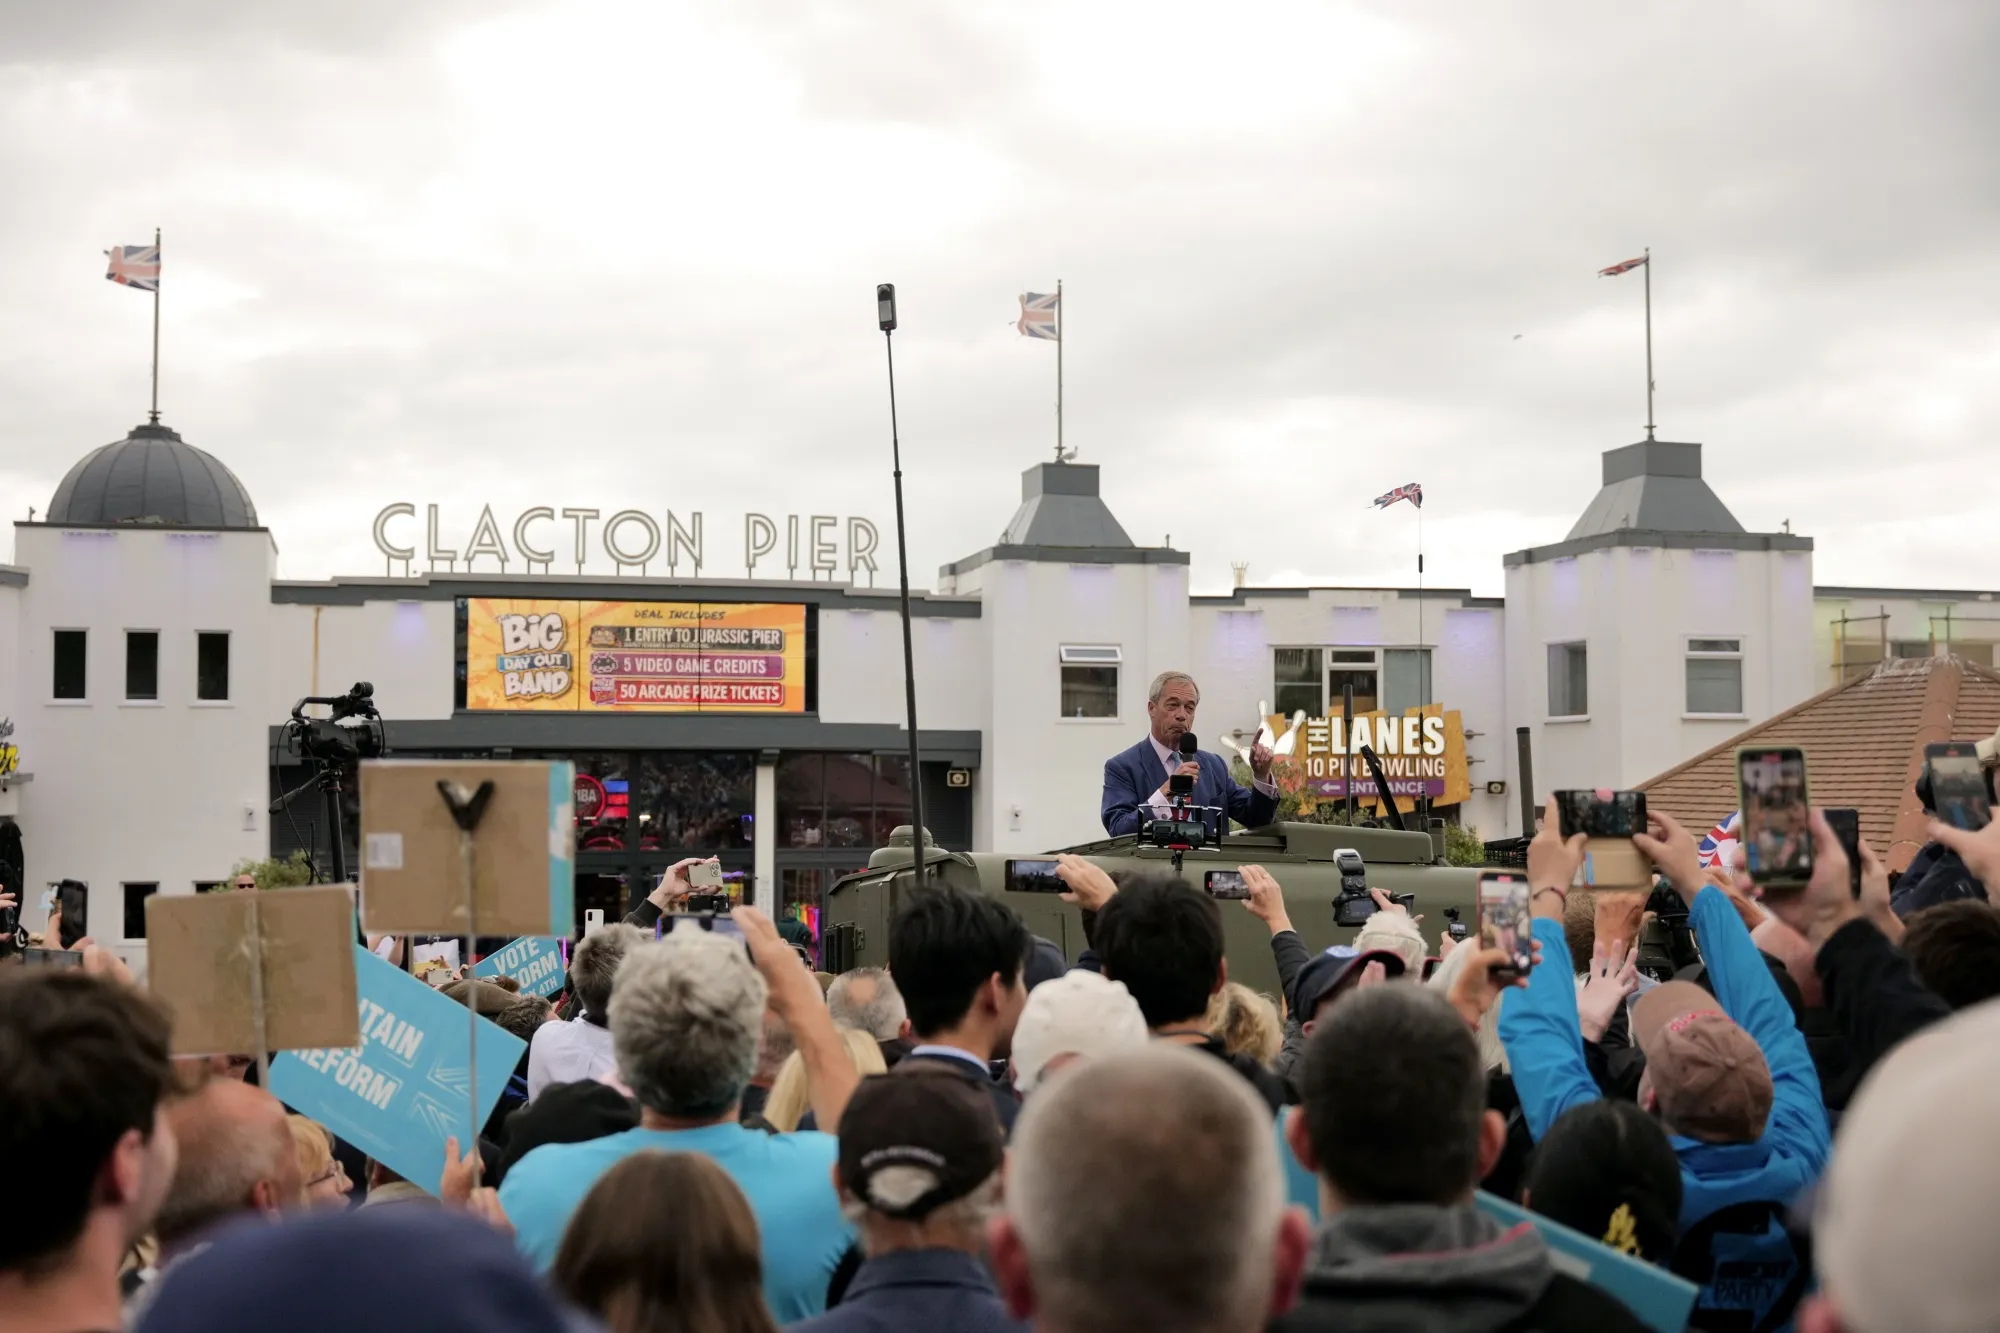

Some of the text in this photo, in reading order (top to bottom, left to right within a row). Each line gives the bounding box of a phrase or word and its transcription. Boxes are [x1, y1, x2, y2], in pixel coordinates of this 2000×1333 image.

[373, 502, 878, 571] CLACTON PIER
[634, 610, 725, 620] DEAL INCLUDES
[624, 627, 780, 644] 1 ENTRY TO JURASSIC PIER
[504, 653, 562, 671] DAY OUT
[624, 657, 767, 674] 5 VIDEO GAME CREDITS
[505, 671, 568, 697] BAND
[620, 684, 636, 698] 50
[639, 684, 690, 699] ARCADE
[693, 684, 728, 699] PRIZE
[730, 686, 780, 700] TICKETS
[1308, 716, 1445, 755] THE LANES
[1306, 758, 1324, 776] 10
[1329, 758, 1358, 776] PIN
[1350, 781, 1426, 793] ENTANCE
[493, 936, 540, 974] VOTE
[540, 975, 557, 995] 4TH
[292, 1048, 397, 1110] EFORM
